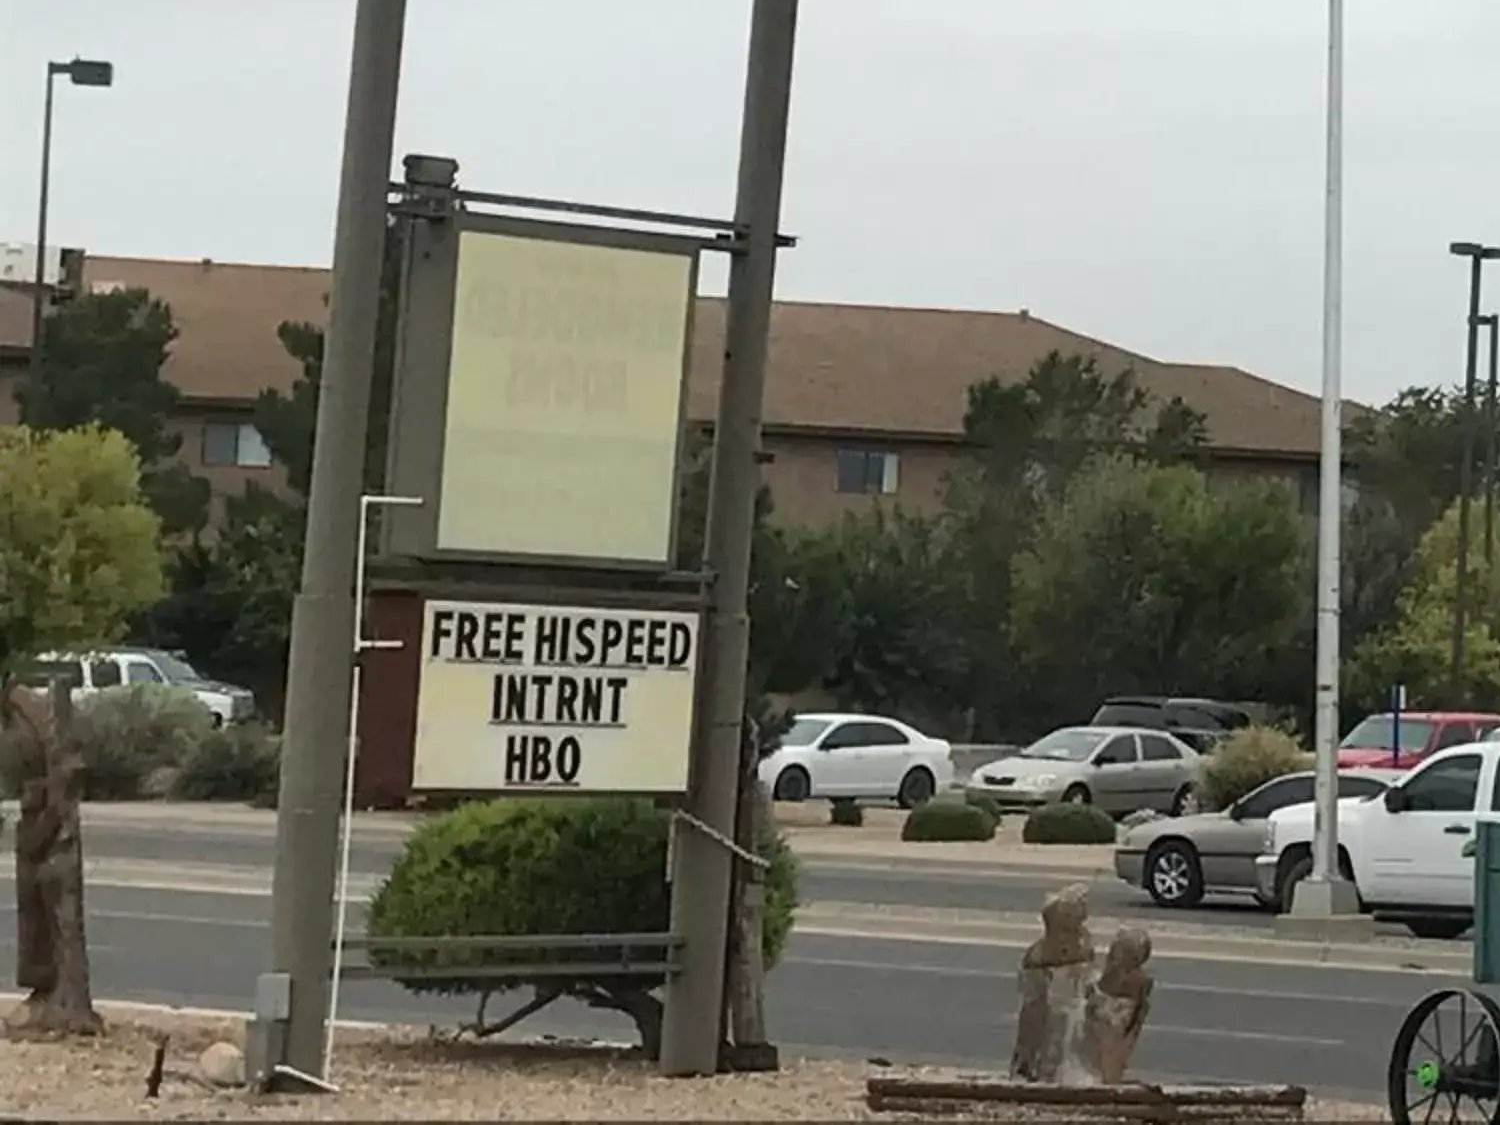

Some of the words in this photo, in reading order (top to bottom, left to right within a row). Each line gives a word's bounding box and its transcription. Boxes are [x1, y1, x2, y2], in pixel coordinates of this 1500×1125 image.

[431, 610, 525, 660] FREE
[533, 615, 692, 666] HISPEED
[491, 673, 628, 723] INTRNT
[504, 734, 582, 783] HBO
